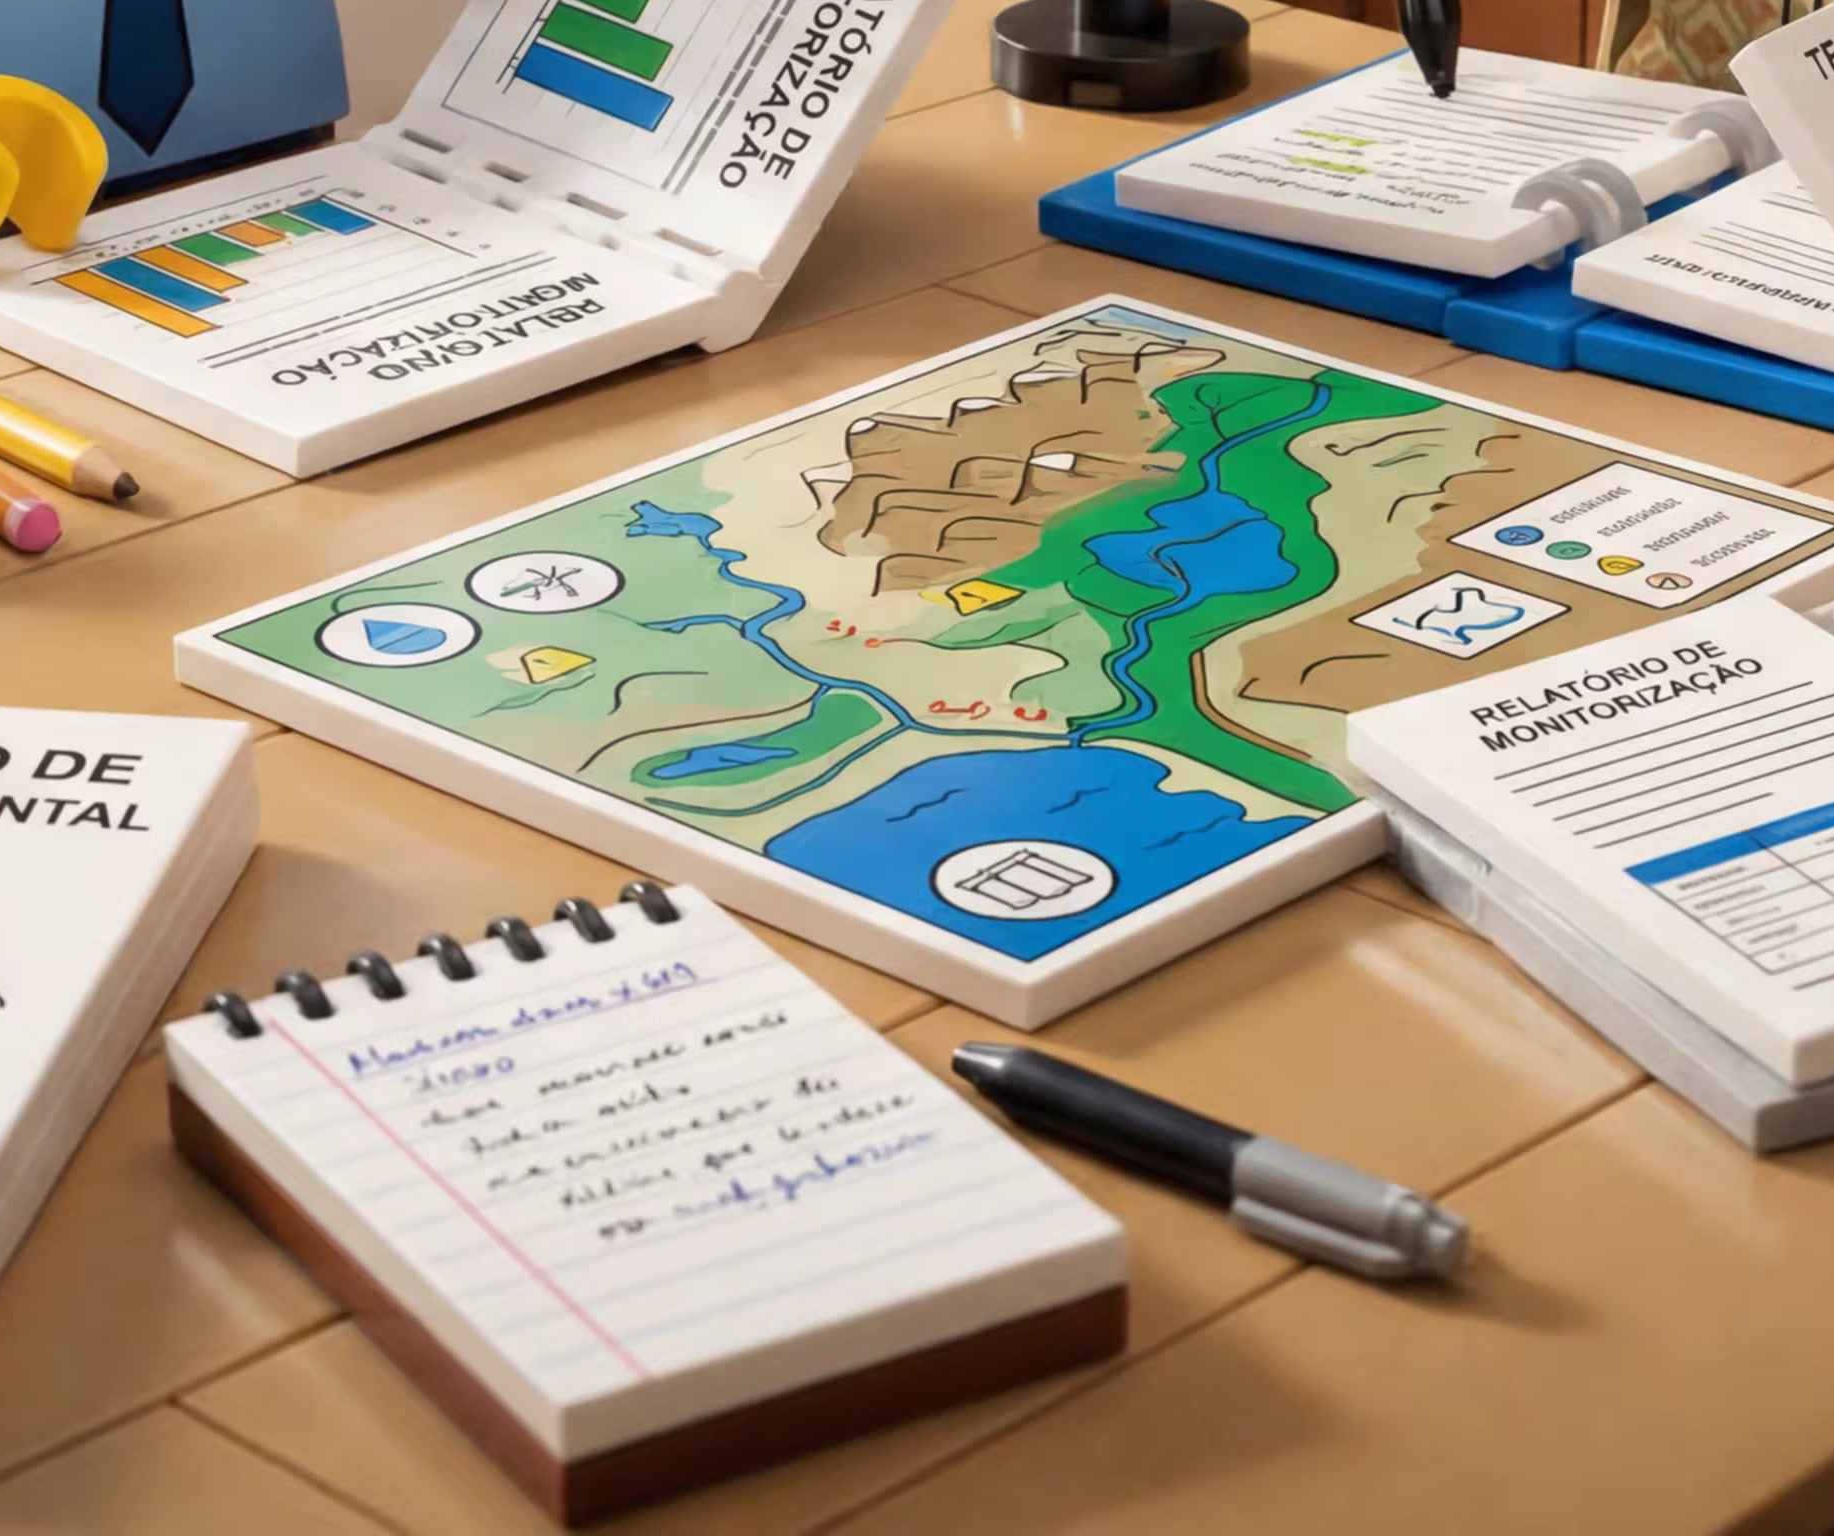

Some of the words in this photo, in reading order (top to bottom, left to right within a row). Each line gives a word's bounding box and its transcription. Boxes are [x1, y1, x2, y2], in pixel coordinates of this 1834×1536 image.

[762, 126, 812, 180] DE
[1469, 656, 1670, 727] RELATÓRIO
[1672, 640, 1728, 666] DE
[1479, 658, 1764, 753] MONITORIZAÇÃO
[30, 748, 144, 786] DE
